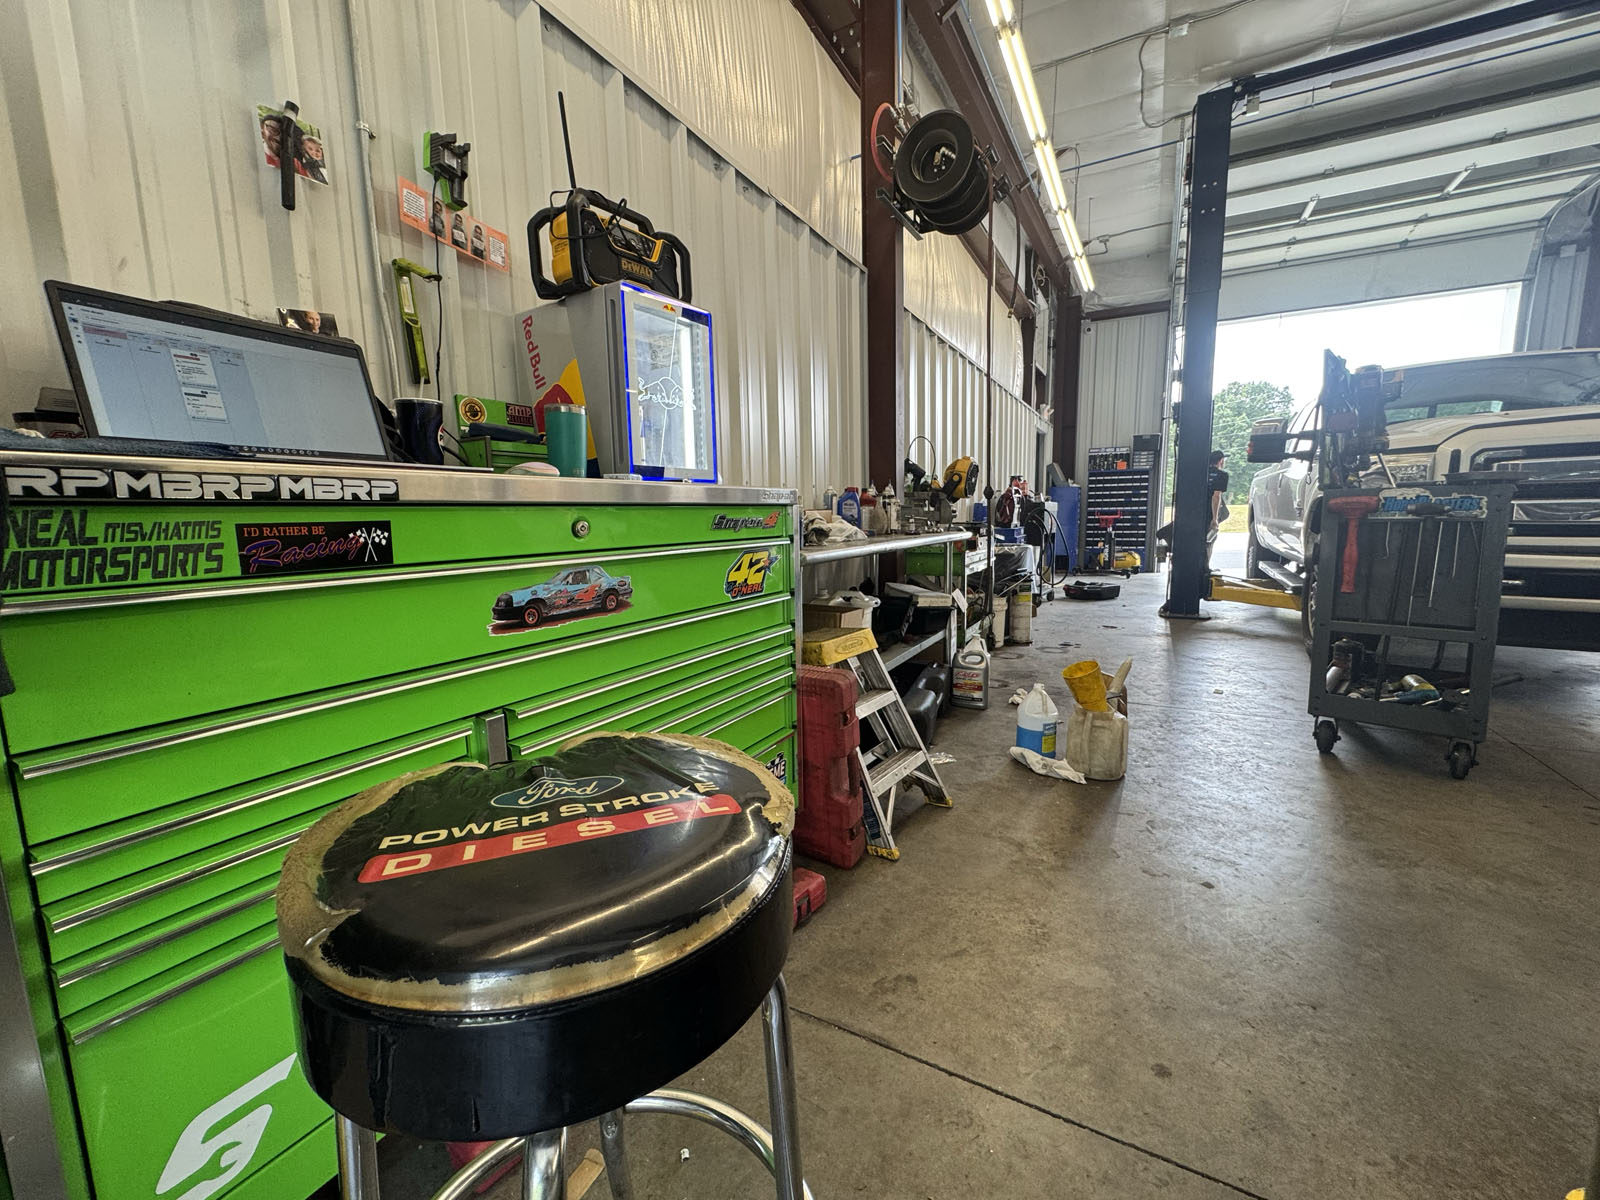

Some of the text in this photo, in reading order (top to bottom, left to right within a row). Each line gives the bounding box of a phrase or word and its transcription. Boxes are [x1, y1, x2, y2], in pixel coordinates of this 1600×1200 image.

[522, 315, 547, 390] Red Bull
[113, 469, 275, 499] MBRP
[279, 477, 398, 501] MBRP
[7, 509, 99, 549] NEAL
[243, 525, 326, 537] I'D RATHER BE
[712, 514, 764, 532] Snap-on
[0, 543, 225, 591] MOTORSPORTS
[240, 534, 364, 574] Racing
[728, 551, 769, 585] 42
[731, 583, 763, 597] O'NEAL
[517, 777, 601, 805] Ford
[378, 780, 721, 850] POWER STROKE
[381, 802, 731, 877] DIESEL
